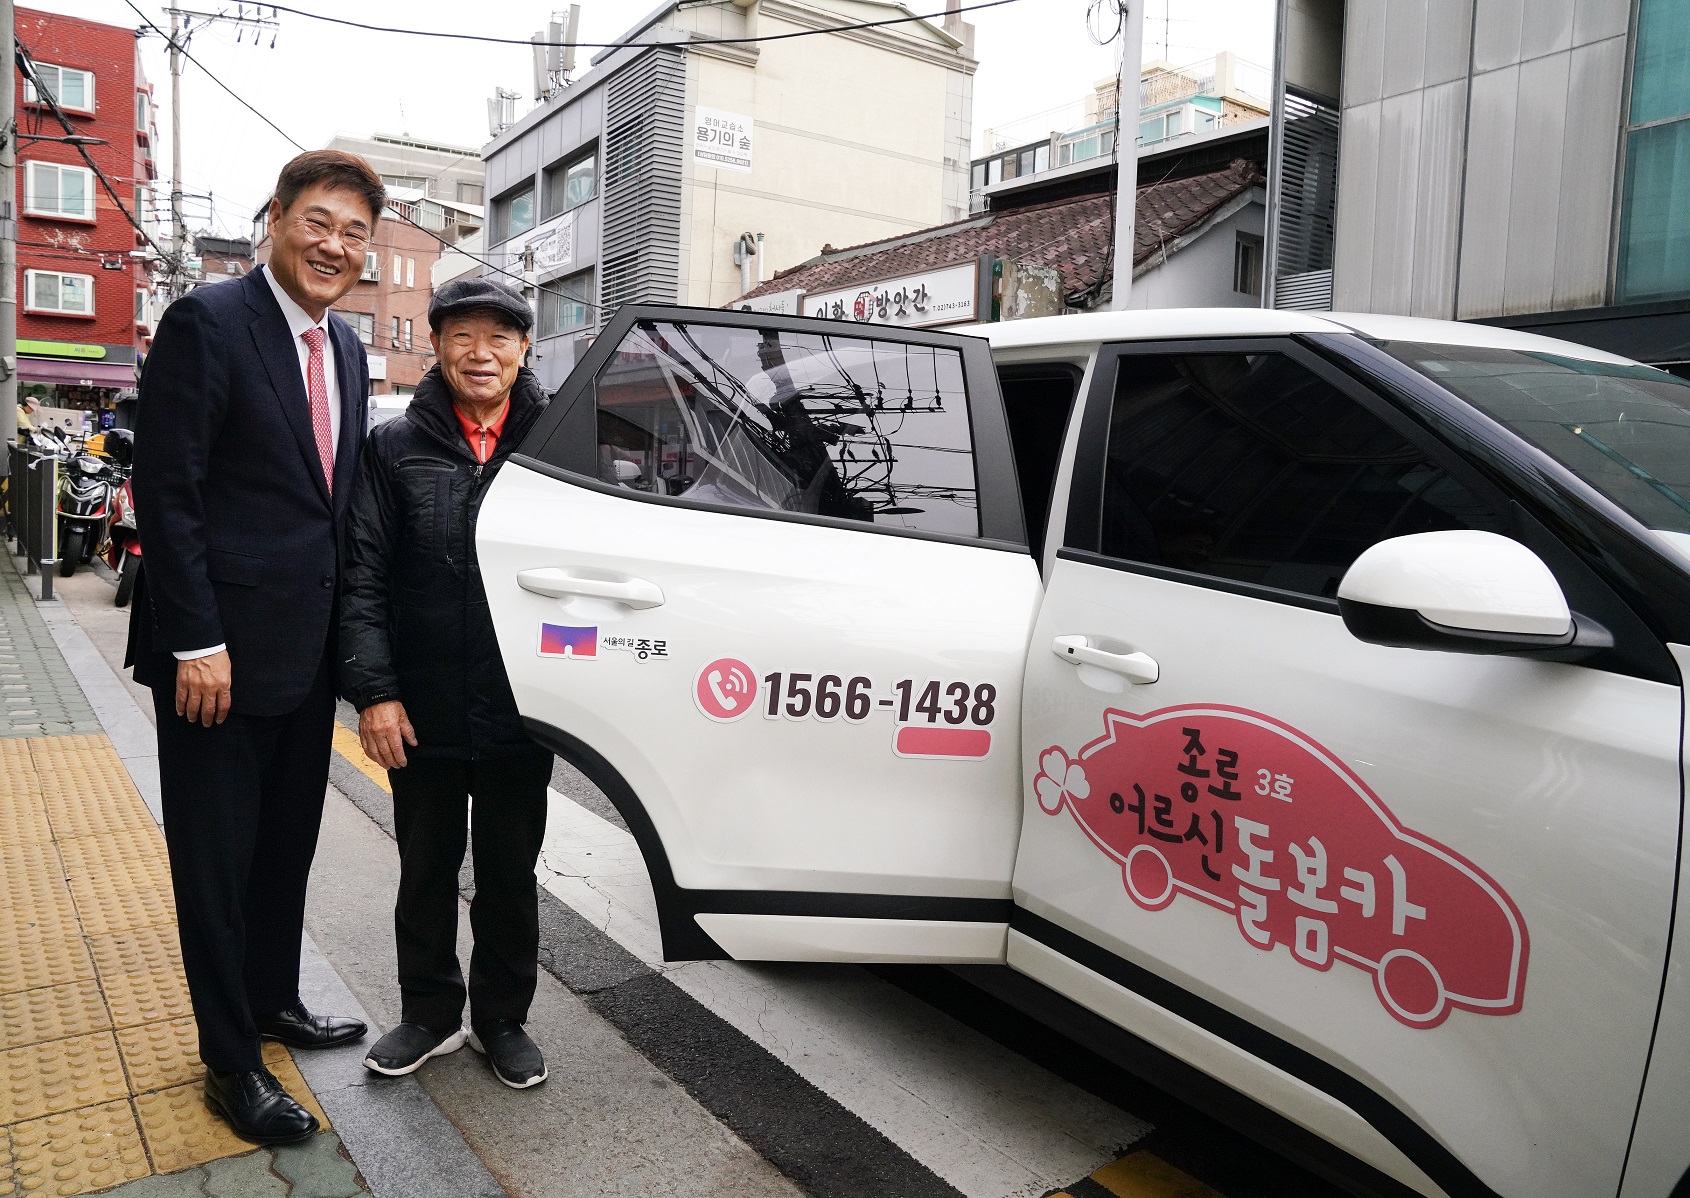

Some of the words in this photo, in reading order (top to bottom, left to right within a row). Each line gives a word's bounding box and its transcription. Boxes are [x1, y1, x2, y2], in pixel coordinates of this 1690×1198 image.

[696, 126, 734, 147] 용기의
[738, 135, 751, 150] 숲
[704, 116, 744, 132] 영어교습소
[875, 283, 929, 318] 방앗간
[603, 636, 626, 647] 서울의
[626, 638, 635, 648] 길
[635, 638, 669, 660] 종로
[763, 672, 997, 726] 1566-1438
[1177, 726, 1242, 803] 종로
[1253, 768, 1295, 804] 3호
[1109, 783, 1224, 882] 어르신
[1231, 814, 1427, 966] 돌봄카
